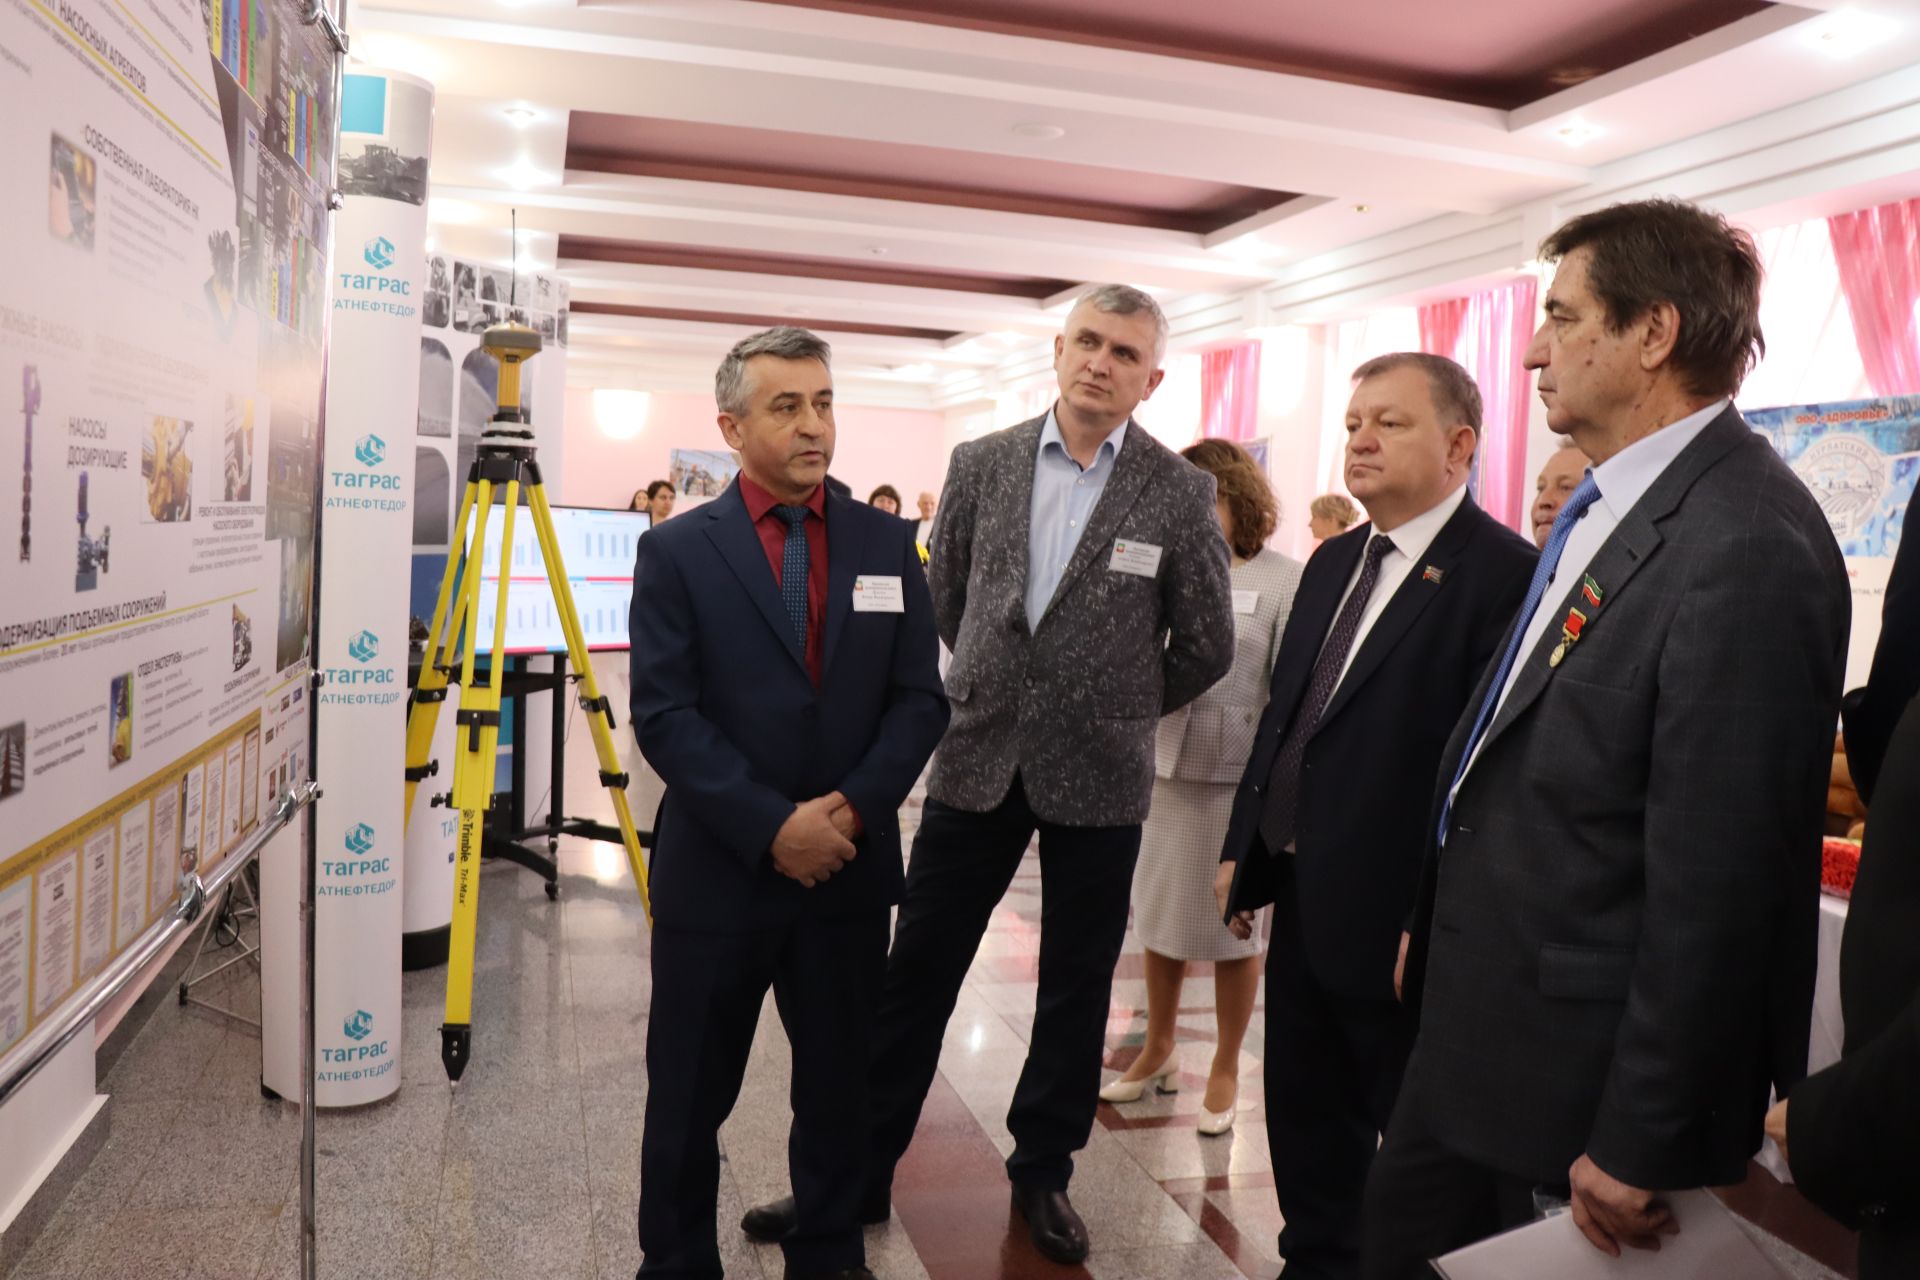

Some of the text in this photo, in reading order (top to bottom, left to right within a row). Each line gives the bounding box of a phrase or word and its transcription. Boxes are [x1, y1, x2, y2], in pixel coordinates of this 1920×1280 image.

[85, 123, 145, 184] СОБСТВЕННАЯ
[333, 298, 417, 318] АТНЕФТЕДОР
[69, 416, 108, 440] НАСОСЫ
[67, 445, 128, 472] ДОЗИРУЮЩИЕ
[324, 496, 407, 512] АТНЕФТЕДОР
[69, 604, 121, 633] ПОДЪЕМНЫХ
[121, 590, 168, 620] СООРУЖЕНИЙ
[319, 692, 400, 706] АТНЕФТЕДОР
[461, 822, 474, 863] Trimble
[317, 879, 396, 897] АТНЕФТЕДОР
[315, 1059, 394, 1082] АТНЕФТЕДОР
